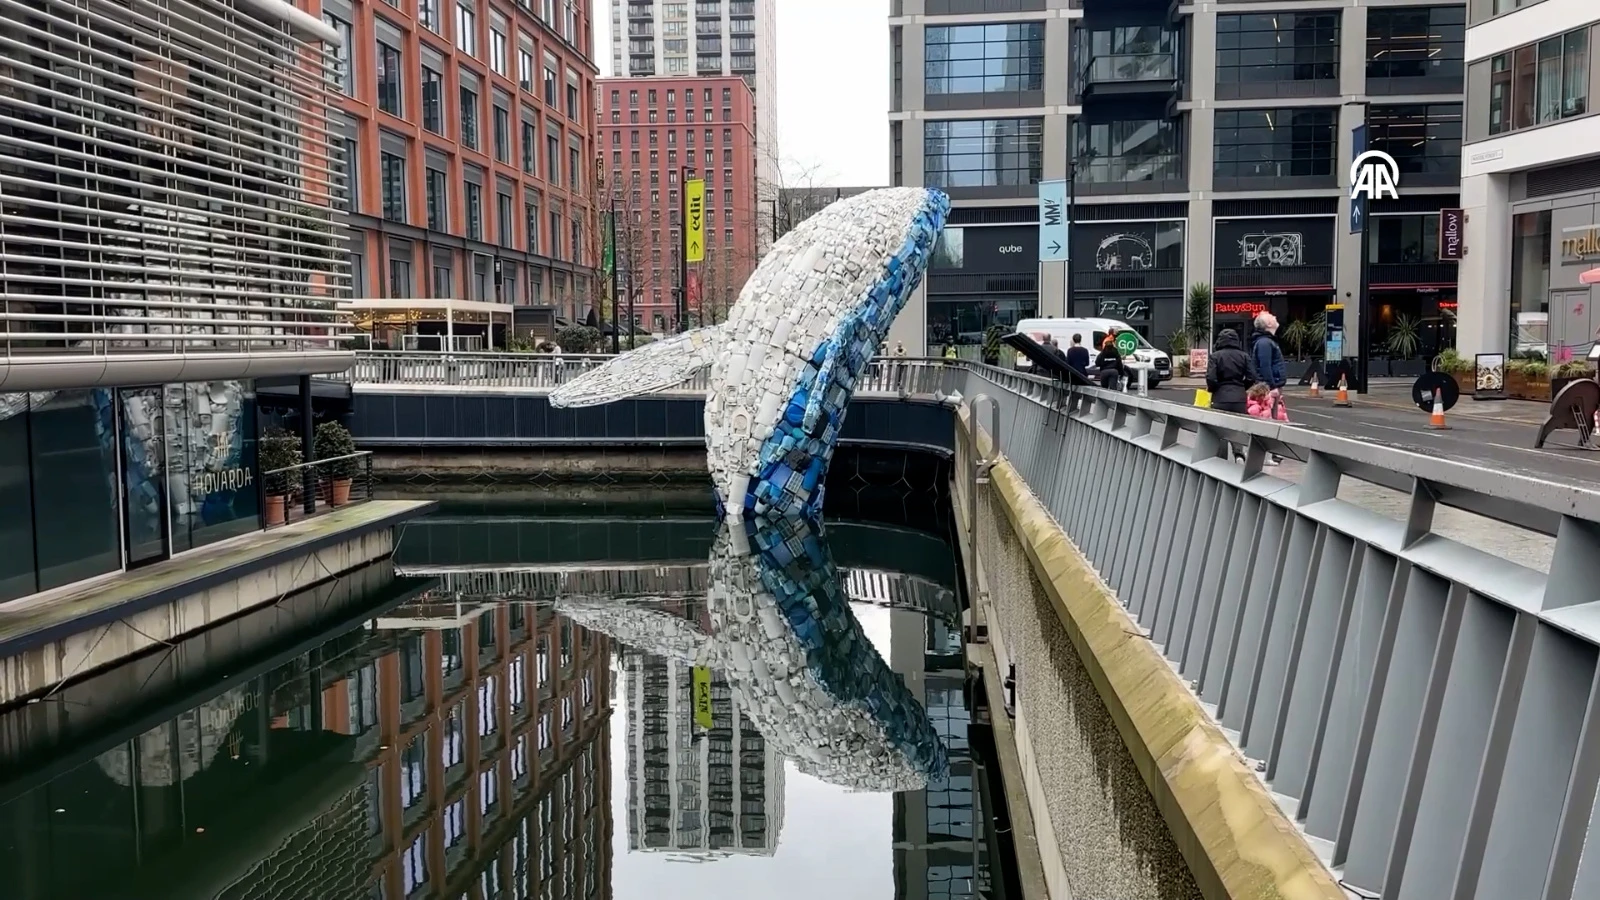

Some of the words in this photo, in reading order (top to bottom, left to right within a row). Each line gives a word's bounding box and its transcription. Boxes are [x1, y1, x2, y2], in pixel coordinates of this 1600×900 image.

[690, 194, 701, 231] edit
[1445, 213, 1459, 256] mallow
[999, 244, 1023, 253] qube
[1215, 302, 1266, 314] Patty&Bun
[1118, 340, 1135, 350] GO
[193, 467, 253, 496] HOVARDA
